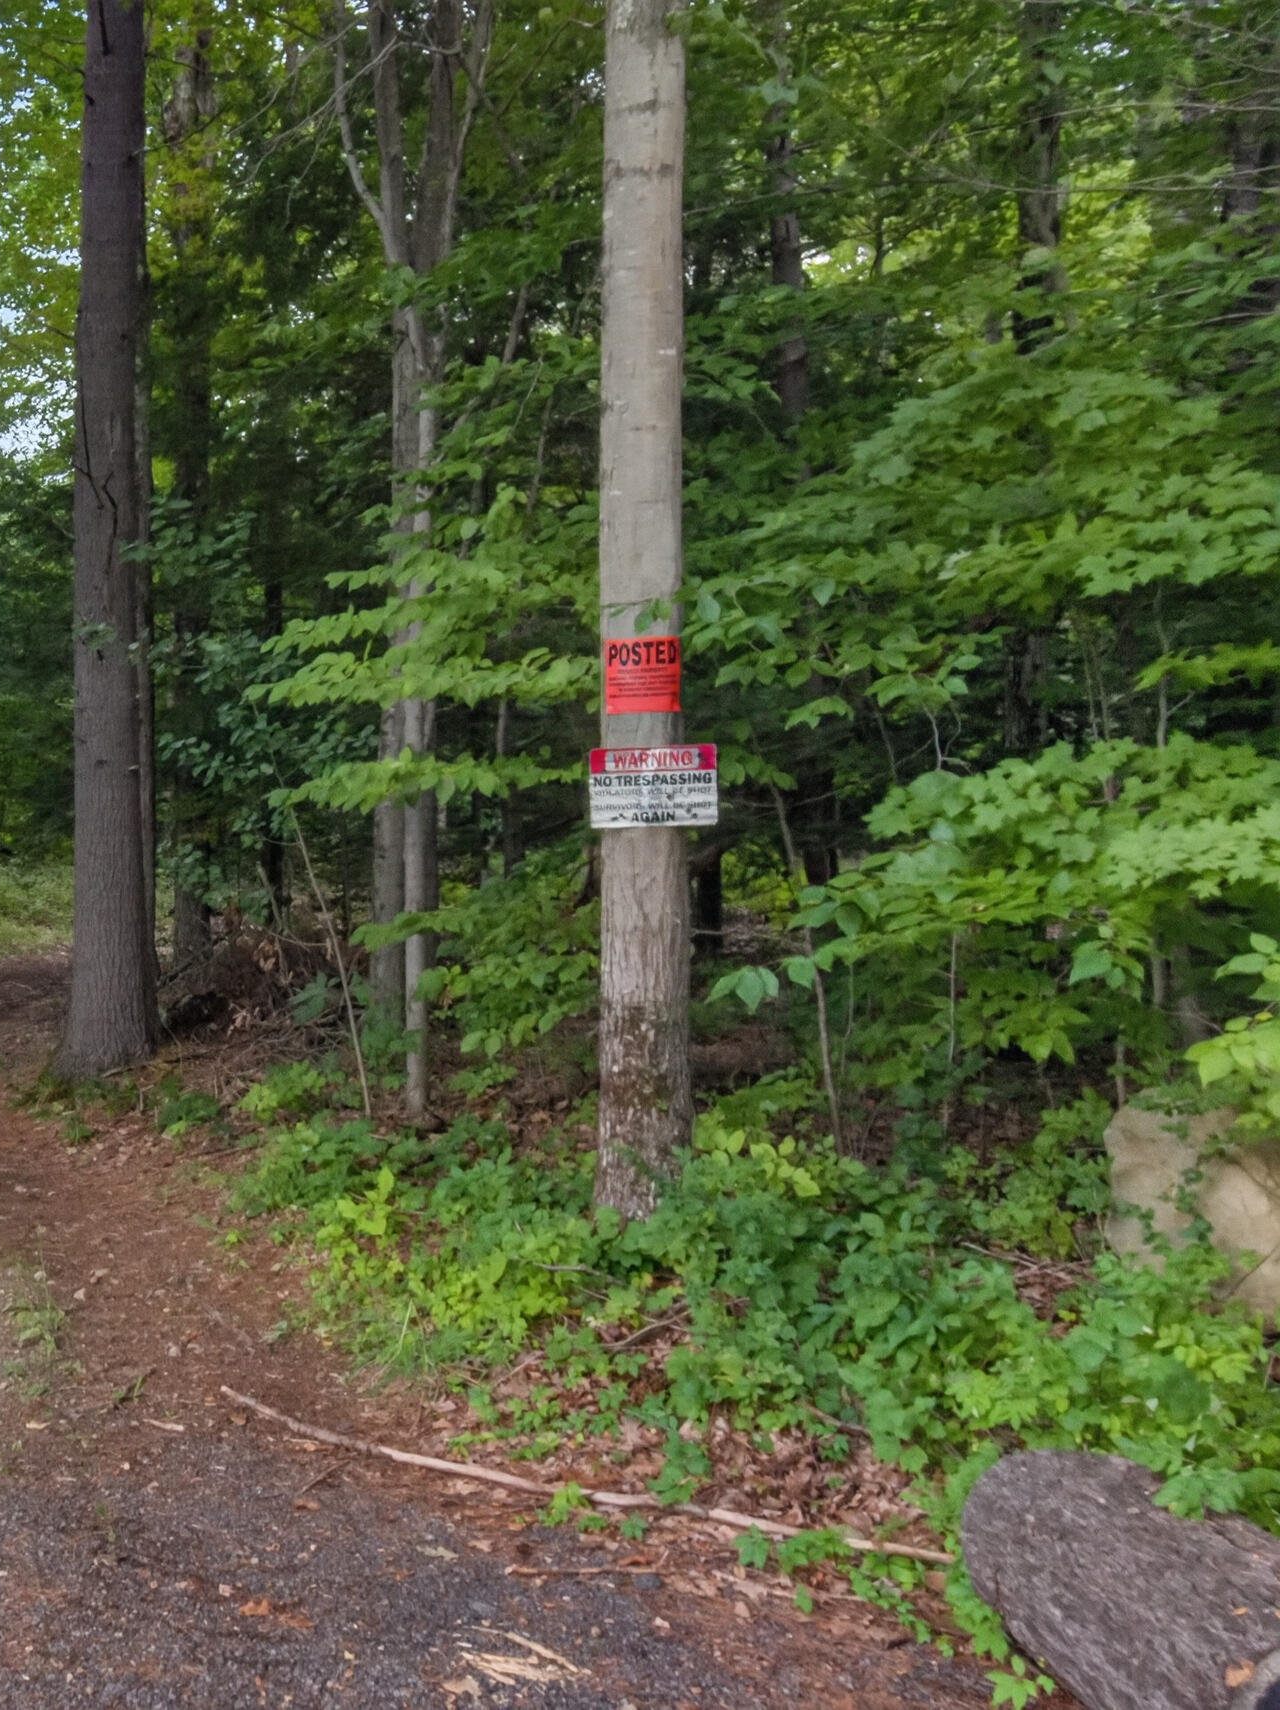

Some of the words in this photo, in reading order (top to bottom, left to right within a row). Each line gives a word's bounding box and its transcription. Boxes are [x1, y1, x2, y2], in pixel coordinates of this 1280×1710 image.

[609, 640, 677, 667] POSTED
[614, 750, 694, 769] WARNING
[594, 777, 613, 787] NO
[615, 772, 713, 786] TRESPASSING
[631, 811, 676, 823] AGAIN
